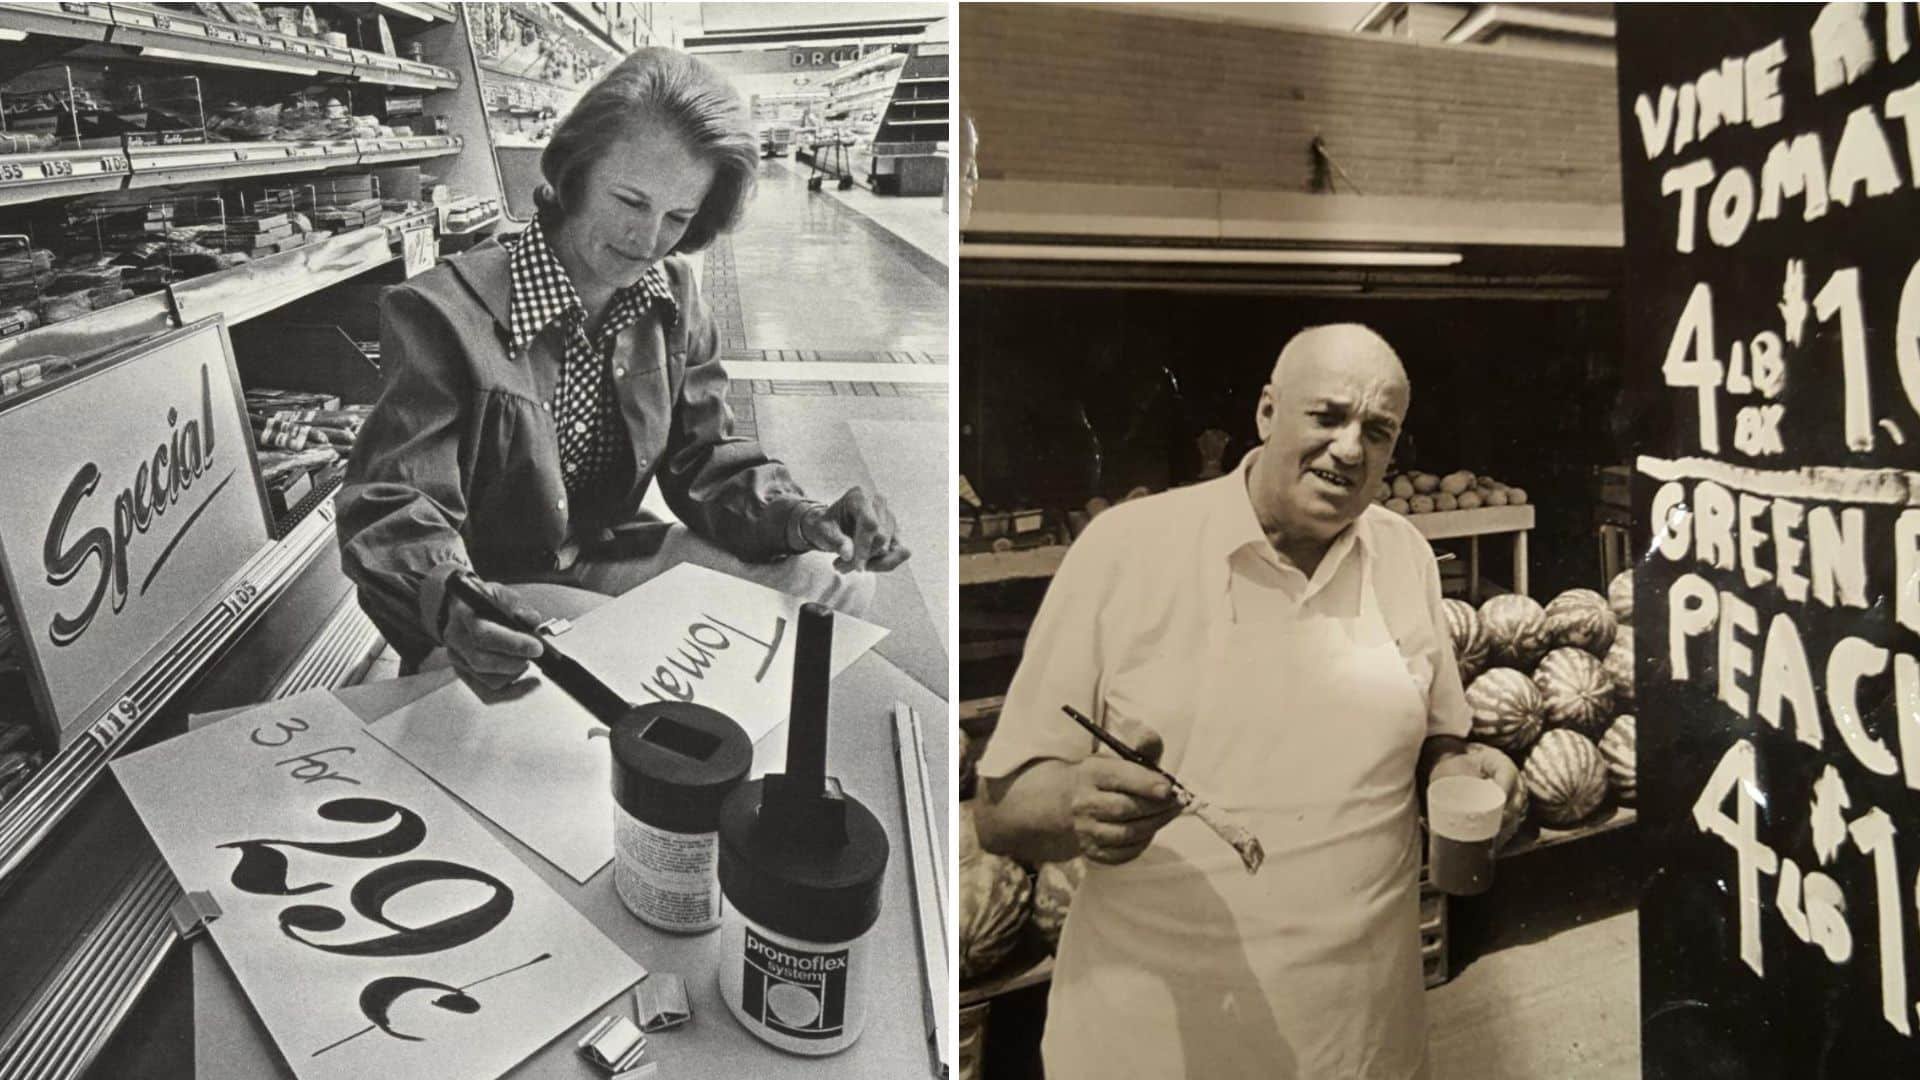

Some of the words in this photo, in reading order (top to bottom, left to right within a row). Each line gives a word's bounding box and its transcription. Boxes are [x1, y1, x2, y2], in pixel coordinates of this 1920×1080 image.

[1635, 39, 1787, 160] VINE
[1811, 2, 1920, 96] RI
[43, 362, 215, 647] Special
[1652, 481, 1869, 609] GREEN
[227, 580, 257, 613] 105
[95, 700, 138, 745] 119
[251, 717, 310, 747] 3
[275, 746, 361, 785] for
[746, 933, 847, 971] promoflex
[767, 960, 823, 982] system
